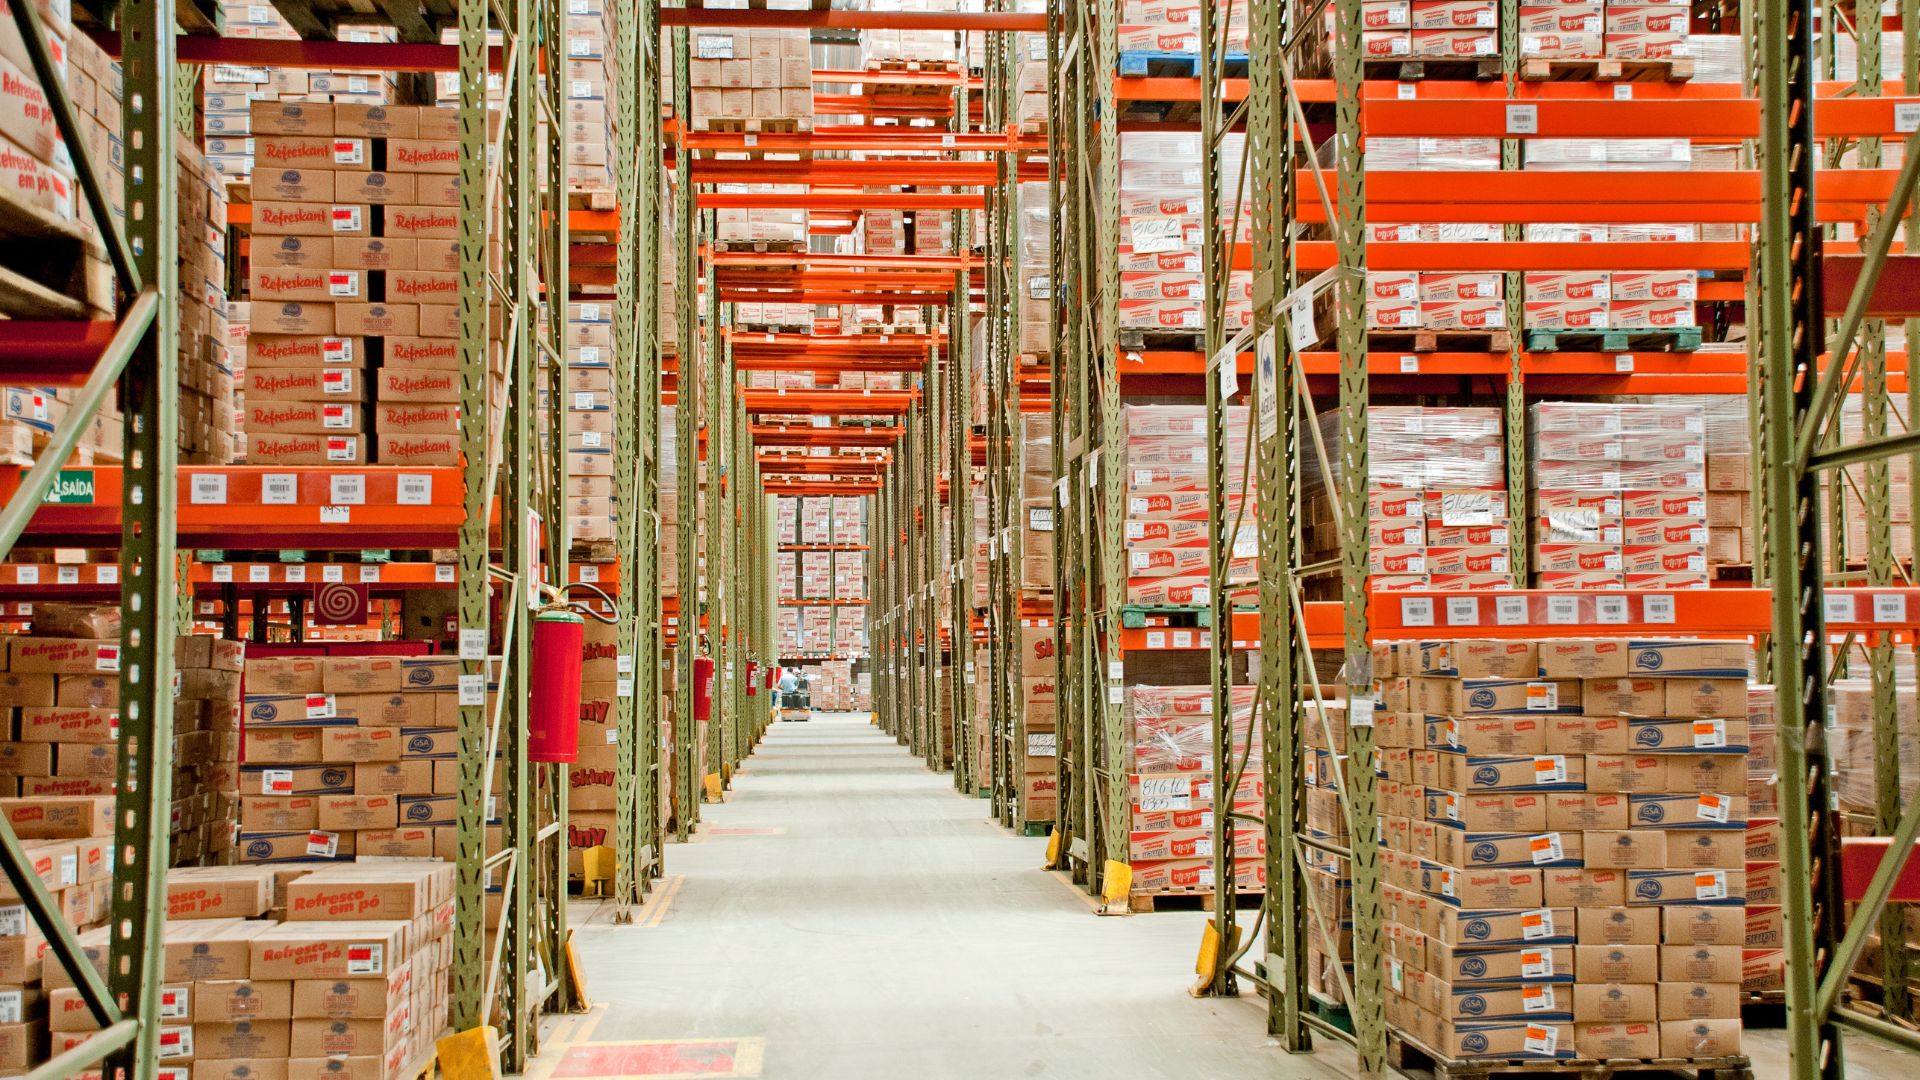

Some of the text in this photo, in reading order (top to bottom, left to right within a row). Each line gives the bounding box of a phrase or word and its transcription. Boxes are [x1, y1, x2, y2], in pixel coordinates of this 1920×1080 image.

[19, 174, 34, 188] em
[62, 479, 93, 496] SAÍDA
[21, 643, 77, 657] Refresco
[49, 650, 68, 662] em
[33, 711, 90, 726] Refresco
[61, 719, 80, 730] em
[570, 768, 616, 789] Skiny
[170, 894, 222, 914] em pó
[294, 890, 364, 911] Refresco
[329, 895, 380, 916] em pó
[264, 943, 328, 962] Refresco
[295, 947, 341, 965] em pó
